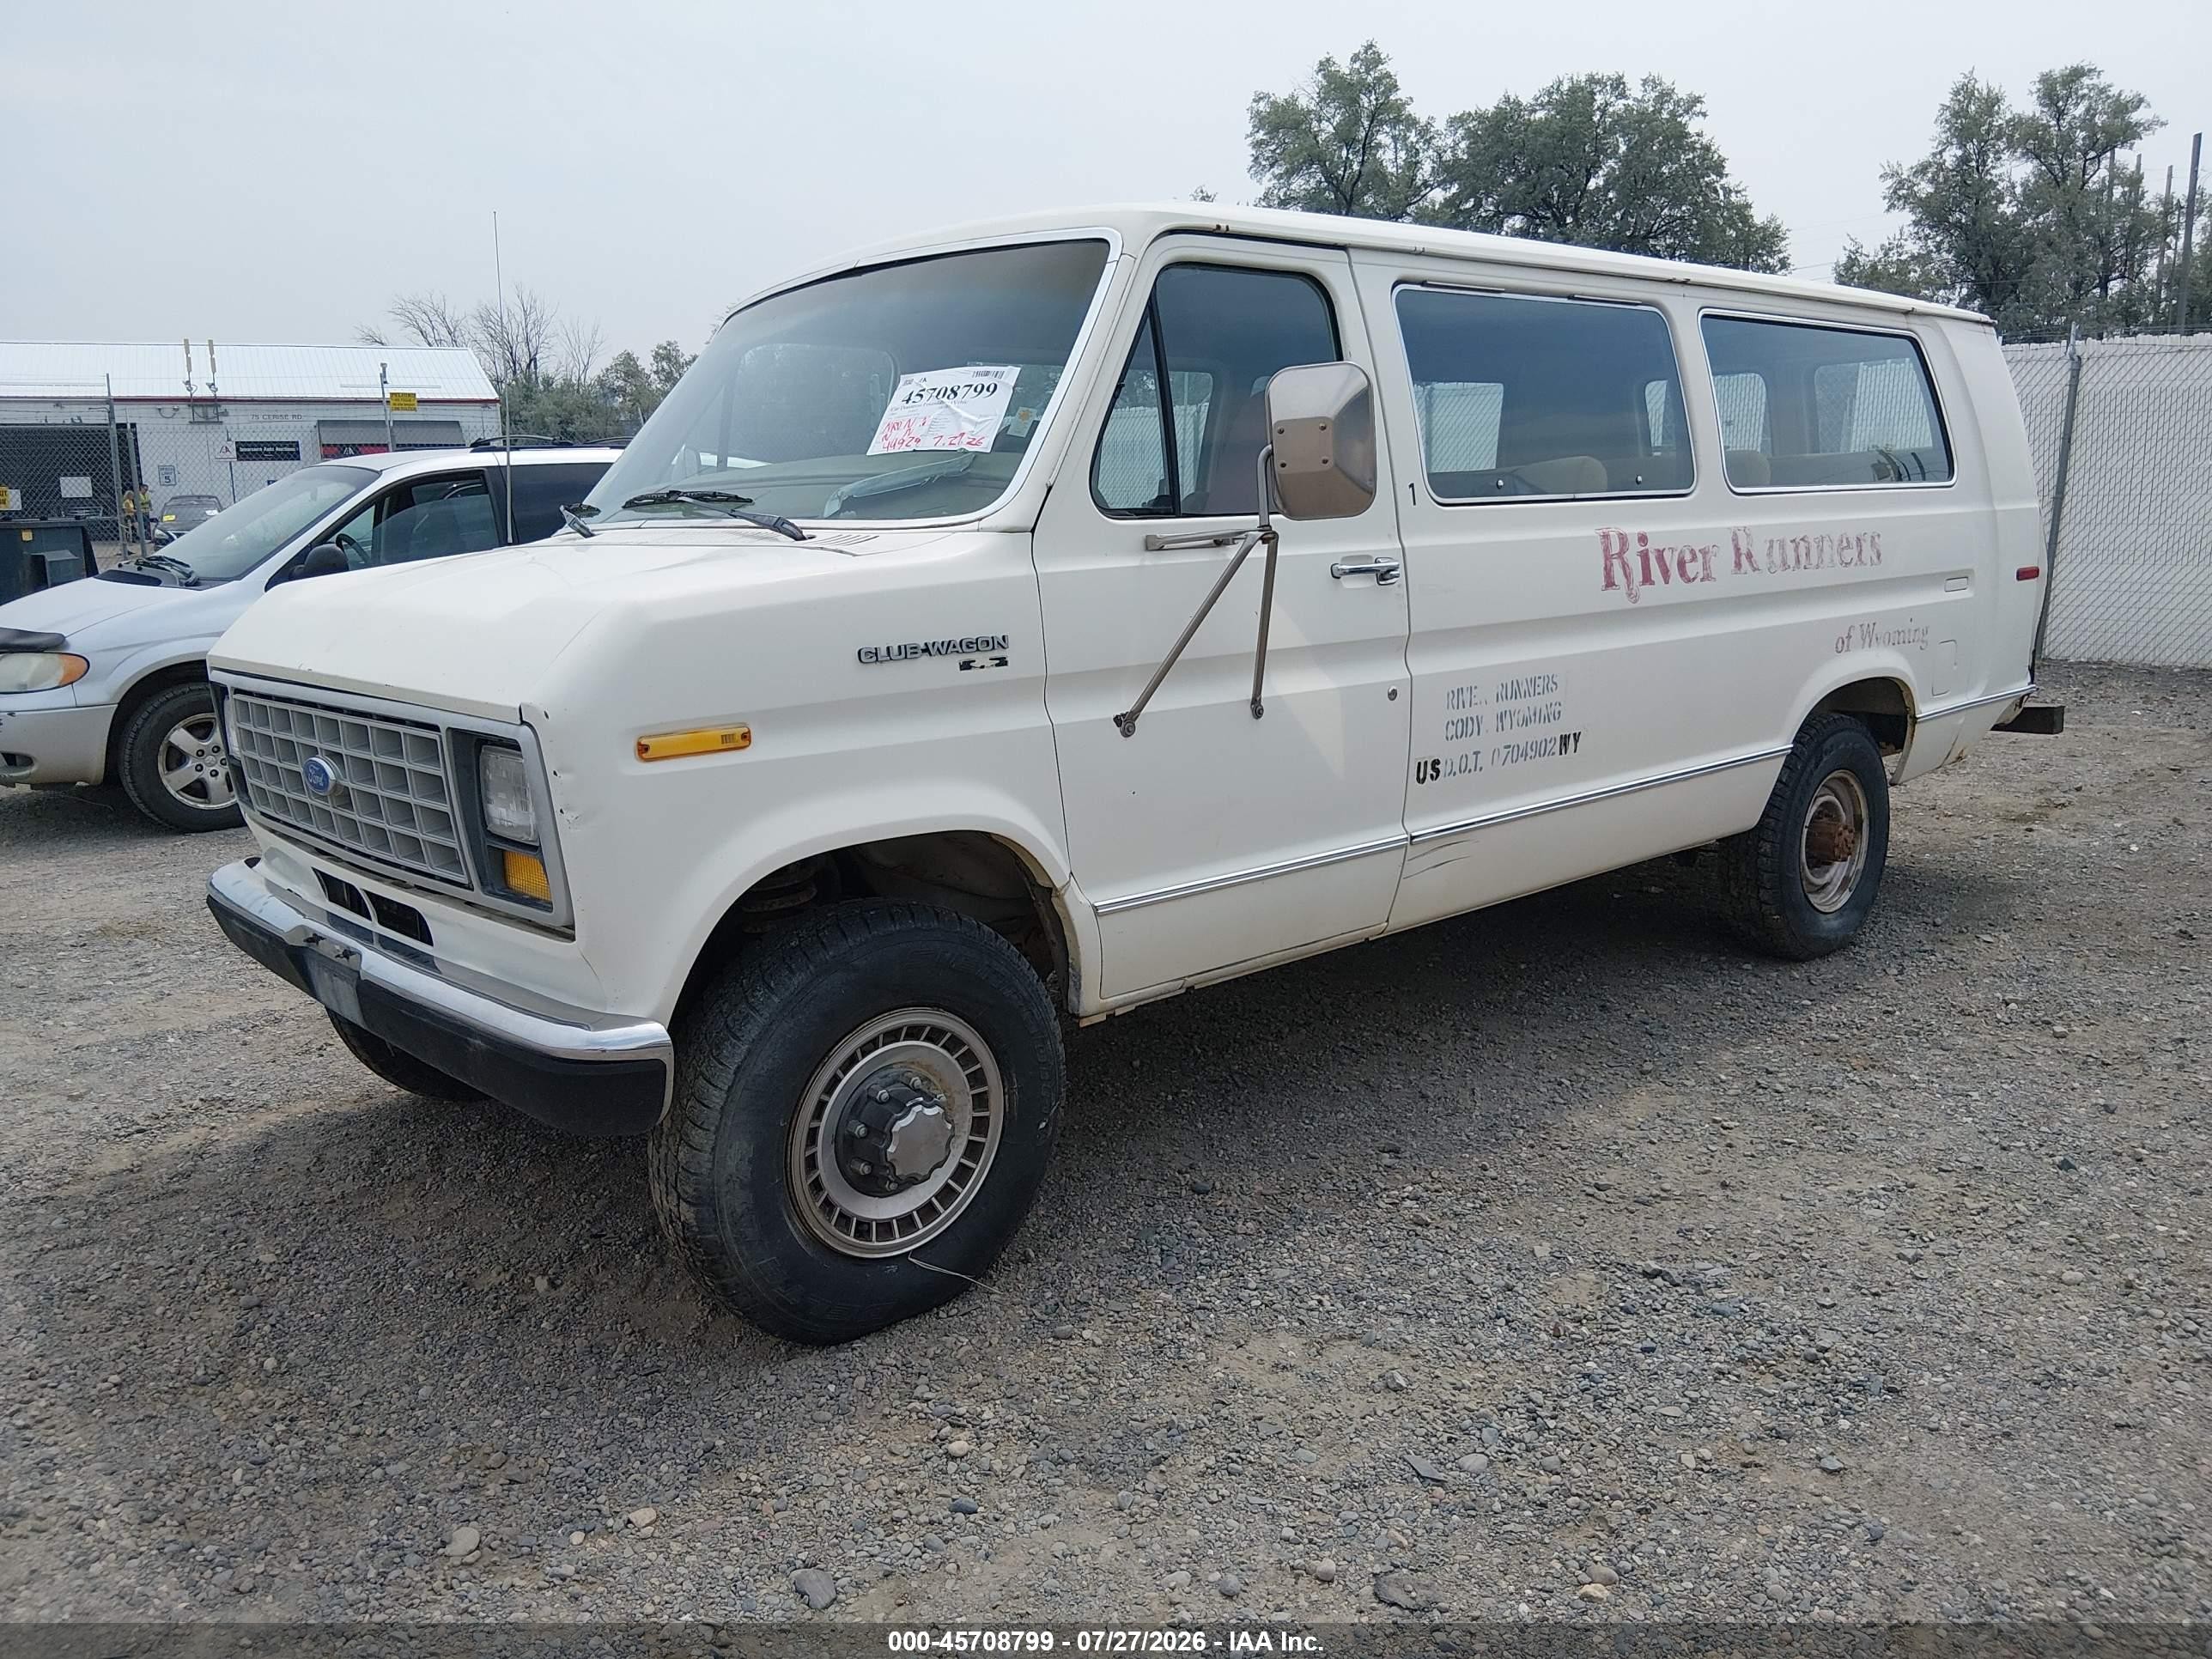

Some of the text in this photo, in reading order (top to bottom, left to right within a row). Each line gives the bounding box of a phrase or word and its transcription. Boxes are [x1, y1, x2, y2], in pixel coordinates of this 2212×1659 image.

[902, 383, 998, 404] 45708799
[1595, 526, 1882, 604] River Runners
[1835, 624, 1855, 653] of
[1446, 673, 1559, 710] RIVE RUNNERS
[1496, 701, 1562, 732] WYOMING
[1416, 758, 1441, 784] US
